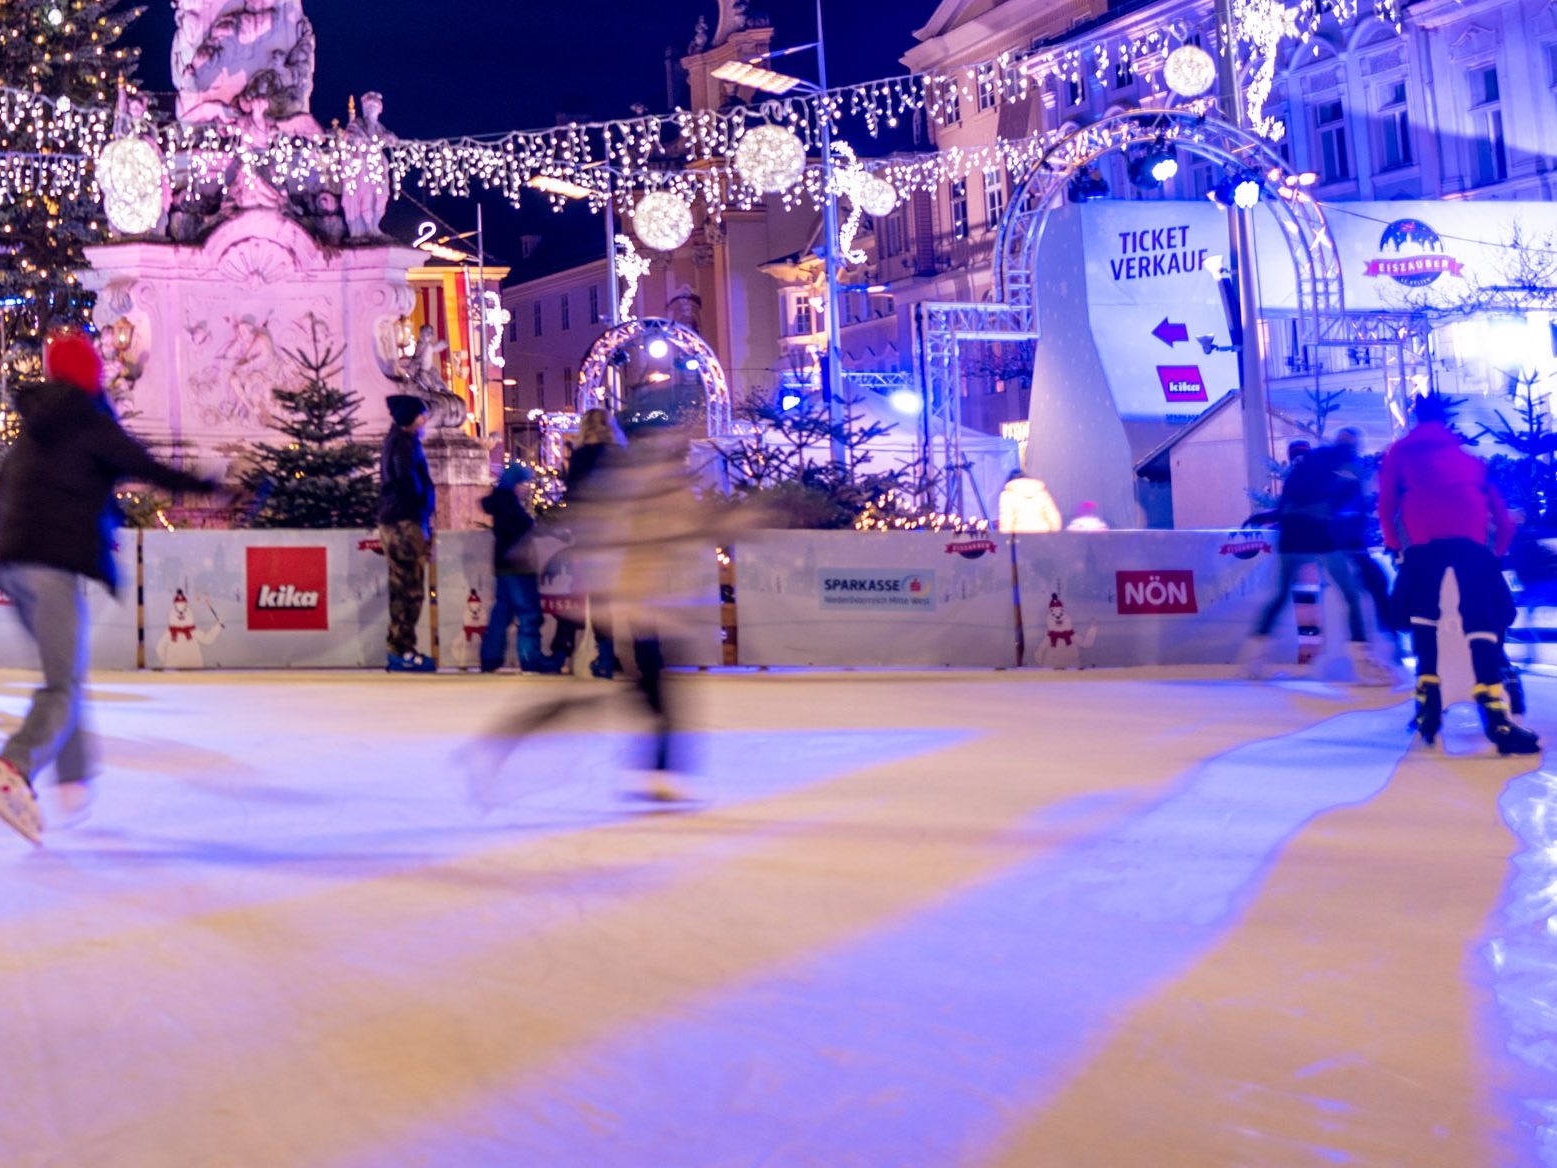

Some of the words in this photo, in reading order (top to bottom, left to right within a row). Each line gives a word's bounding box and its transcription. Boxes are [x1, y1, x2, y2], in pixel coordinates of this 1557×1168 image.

[1119, 225, 1190, 254] TICKET
[1110, 248, 1208, 281] VERKAUF
[1378, 258, 1450, 272] EISZAUBER
[1168, 379, 1201, 392] kika
[257, 584, 320, 609] kika
[824, 578, 901, 592] SPARKASSE
[1124, 575, 1188, 606] NÖN
